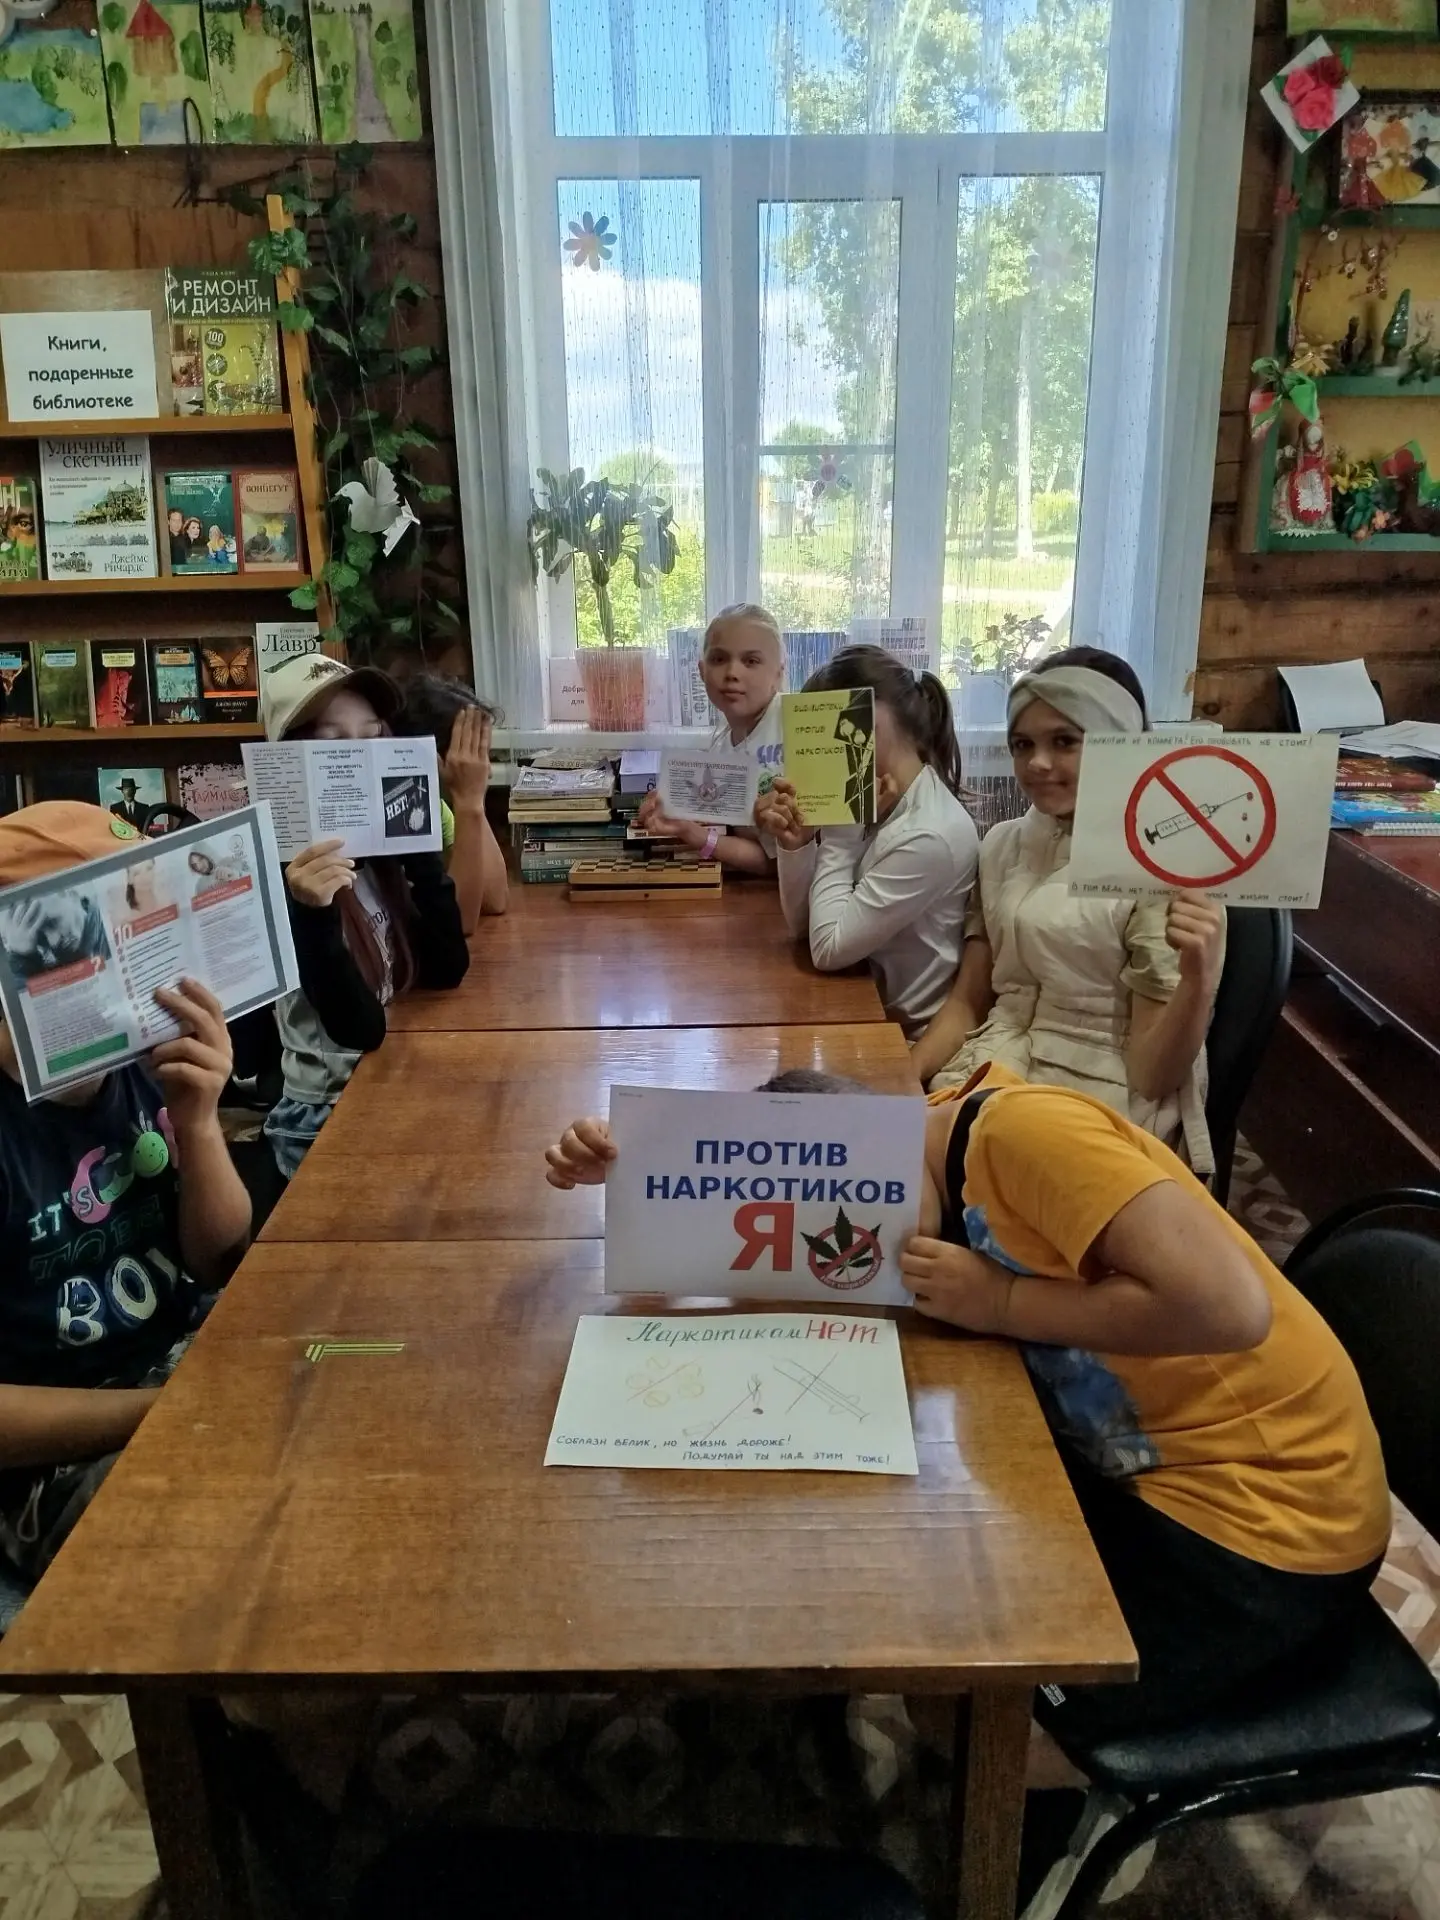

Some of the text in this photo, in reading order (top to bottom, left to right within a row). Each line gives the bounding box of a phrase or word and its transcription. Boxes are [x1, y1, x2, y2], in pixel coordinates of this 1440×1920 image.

[183, 279, 259, 296] РЕМОНТ
[173, 295, 271, 316] И ДИЗАЙН
[47, 335, 108, 352] Книги,
[208, 331, 224, 343] 100
[28, 366, 134, 382] подаренные
[32, 394, 134, 410] библиотеке
[46, 440, 126, 457] УЛИЧНЫЙ
[63, 454, 142, 469] СКЕТЧИНГ
[112, 553, 149, 563] Джеймс
[104, 562, 145, 574] Ричардс
[262, 634, 317, 654] Лавр
[796, 746, 845, 755] НАРКОТИКОВ
[1129, 886, 1143, 894] НЕТ
[695, 1139, 848, 1167] ПРОТИВ
[646, 1175, 905, 1205] НАРКОТИКОВ
[729, 1202, 795, 1272] Я
[626, 1321, 803, 1348] Наркотикам
[663, 1438, 678, 1449] НО
[689, 1438, 728, 1449] ЖИЗНЬ
[754, 1452, 769, 1462] ТЫ
[780, 1451, 805, 1462] НАД
[813, 1451, 844, 1462] ЭТИМ
